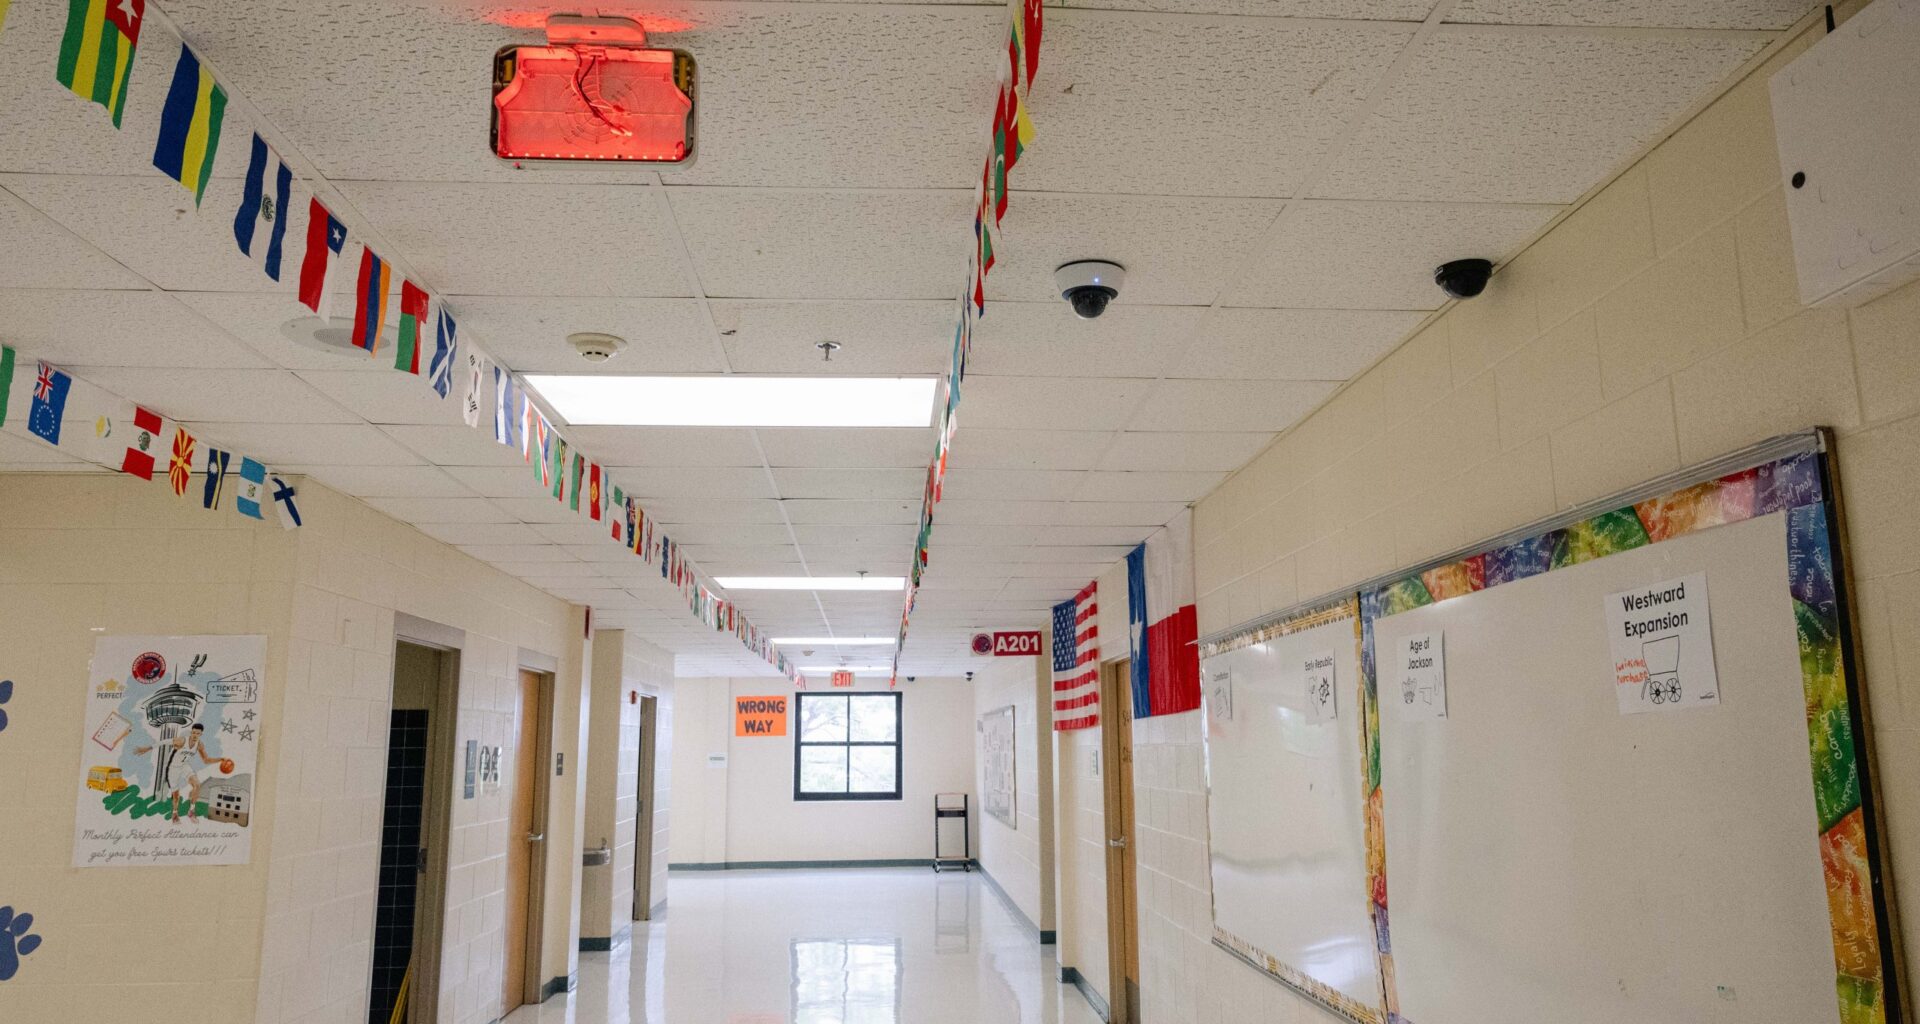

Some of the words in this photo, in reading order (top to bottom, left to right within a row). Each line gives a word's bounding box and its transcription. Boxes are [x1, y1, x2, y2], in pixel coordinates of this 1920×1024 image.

[1622, 582, 1685, 612] Westward
[1624, 612, 1689, 639] Expansion
[995, 635, 1039, 652] A201
[1409, 640, 1423, 654] Age
[1423, 636, 1430, 650] of
[1408, 657, 1433, 670] Jackson
[834, 672, 852, 687] EXIT
[737, 701, 786, 714] WRONG
[744, 719, 774, 734] WAY
[82, 829, 122, 844] Monthly
[125, 829, 160, 842] Perfect
[163, 828, 218, 839] Attendance
[90, 849, 106, 863] get
[108, 850, 127, 863] you
[127, 847, 149, 861] free
[151, 846, 178, 862] Spurs
[179, 845, 227, 857] tickets!!!
